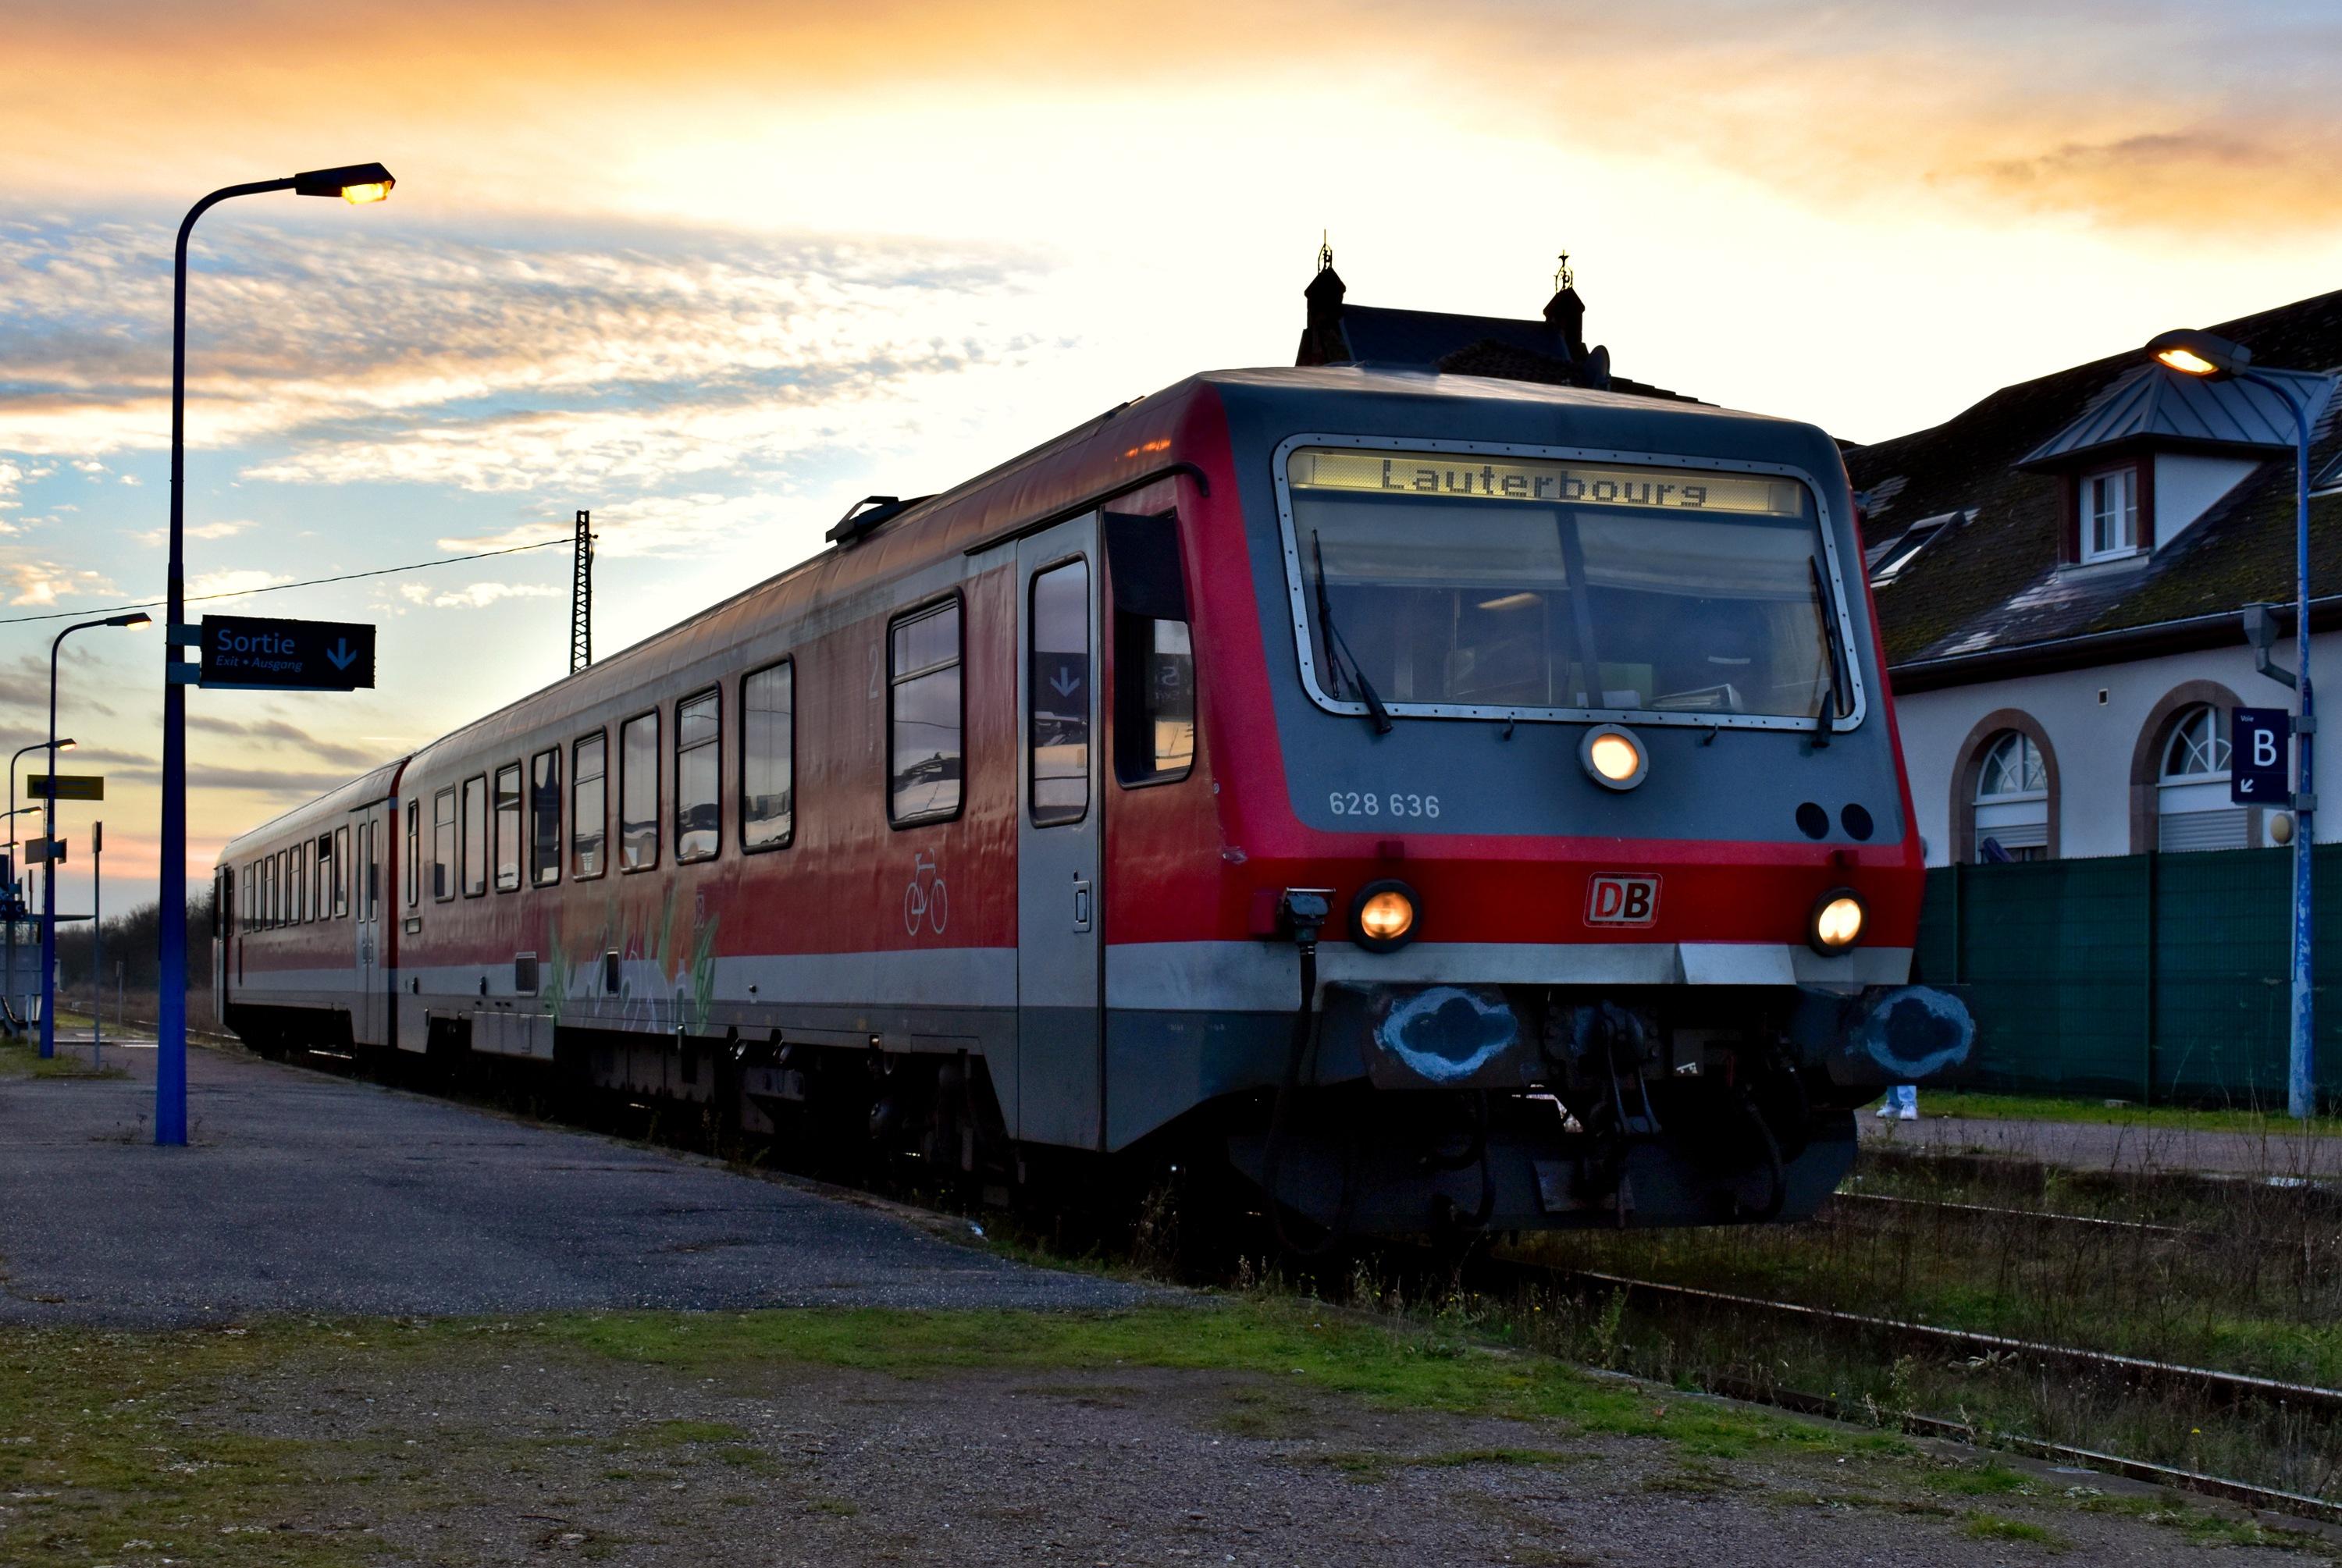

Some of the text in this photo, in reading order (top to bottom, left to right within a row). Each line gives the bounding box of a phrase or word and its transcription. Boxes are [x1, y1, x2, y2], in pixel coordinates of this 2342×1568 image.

[1382, 459, 1707, 508] Lauterbourg
[217, 629, 295, 655] Sortie
[215, 655, 303, 673] Exit Ausgang
[2254, 729, 2277, 766] B
[1329, 791, 1440, 819] 628 636
[1594, 881, 1651, 919] DB
